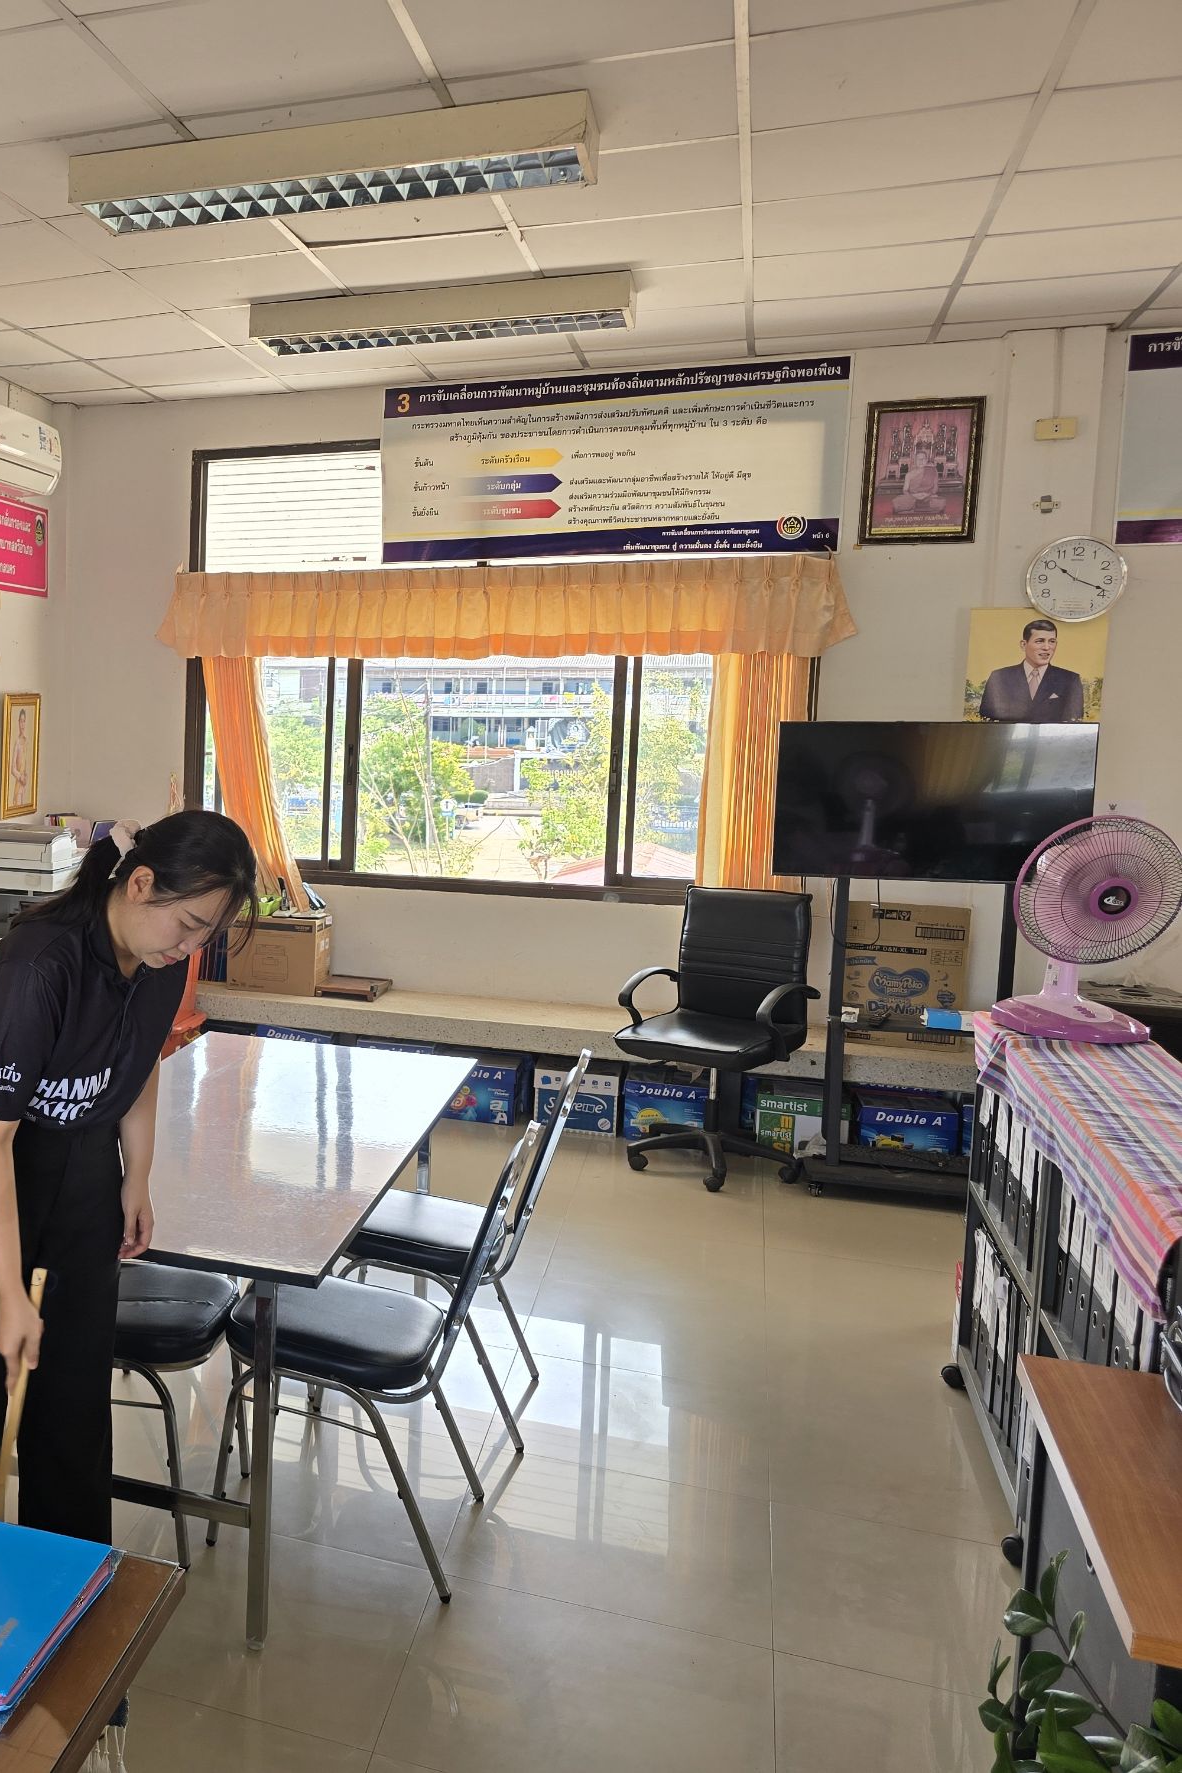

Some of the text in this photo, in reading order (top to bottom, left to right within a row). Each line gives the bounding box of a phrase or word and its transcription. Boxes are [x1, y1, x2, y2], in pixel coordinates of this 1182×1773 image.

[1148, 336, 1182, 352] การขั
[397, 393, 410, 413] 3
[731, 417, 753, 426] ระดับ
[756, 416, 768, 425] คือ
[1058, 550, 1066, 559] 11
[1073, 546, 1085, 557] 12
[1044, 560, 1057, 570] 10
[1101, 561, 1111, 570] 2
[1038, 575, 1048, 584] 9
[1103, 575, 1113, 585] 3
[1041, 589, 1051, 598] 8
[639, 1084, 697, 1100] Double A
[760, 1099, 808, 1113] smartist
[875, 1111, 943, 1126] Double A
[760, 1128, 792, 1140] smartist
